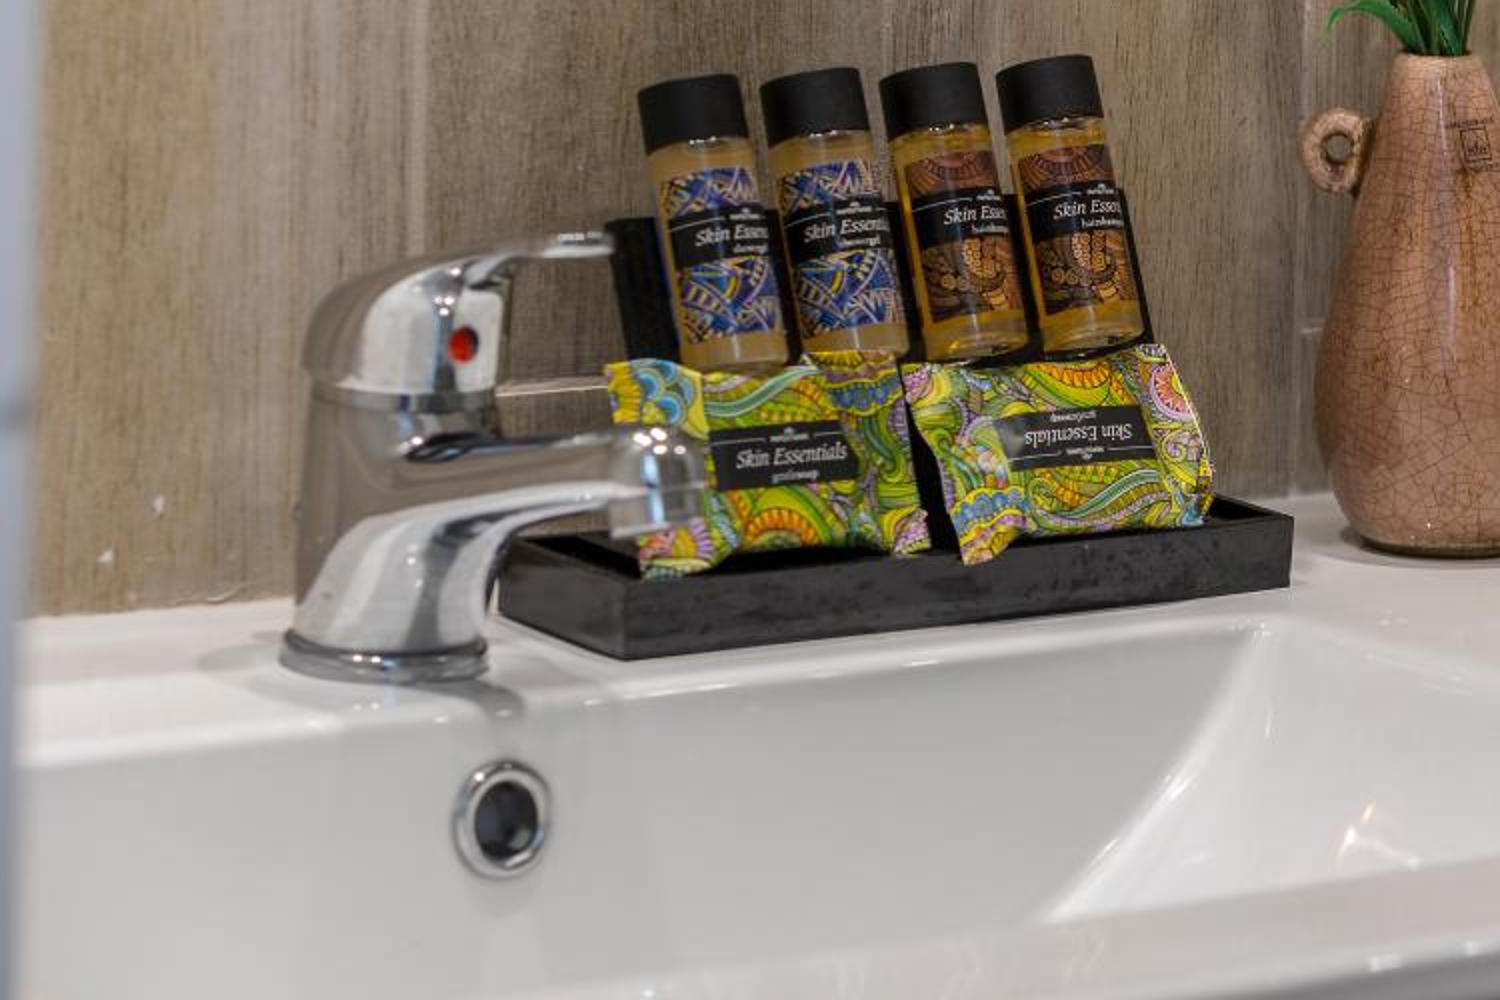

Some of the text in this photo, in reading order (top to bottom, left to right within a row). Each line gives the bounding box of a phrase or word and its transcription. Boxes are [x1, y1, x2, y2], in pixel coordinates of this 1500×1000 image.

[943, 207, 977, 225] Skin
[1053, 202, 1087, 220] Skin
[694, 227, 731, 247] Skin
[803, 222, 836, 243] Skin
[1023, 422, 1133, 449] Skin Essentials
[735, 440, 848, 469] Skin Essentials
